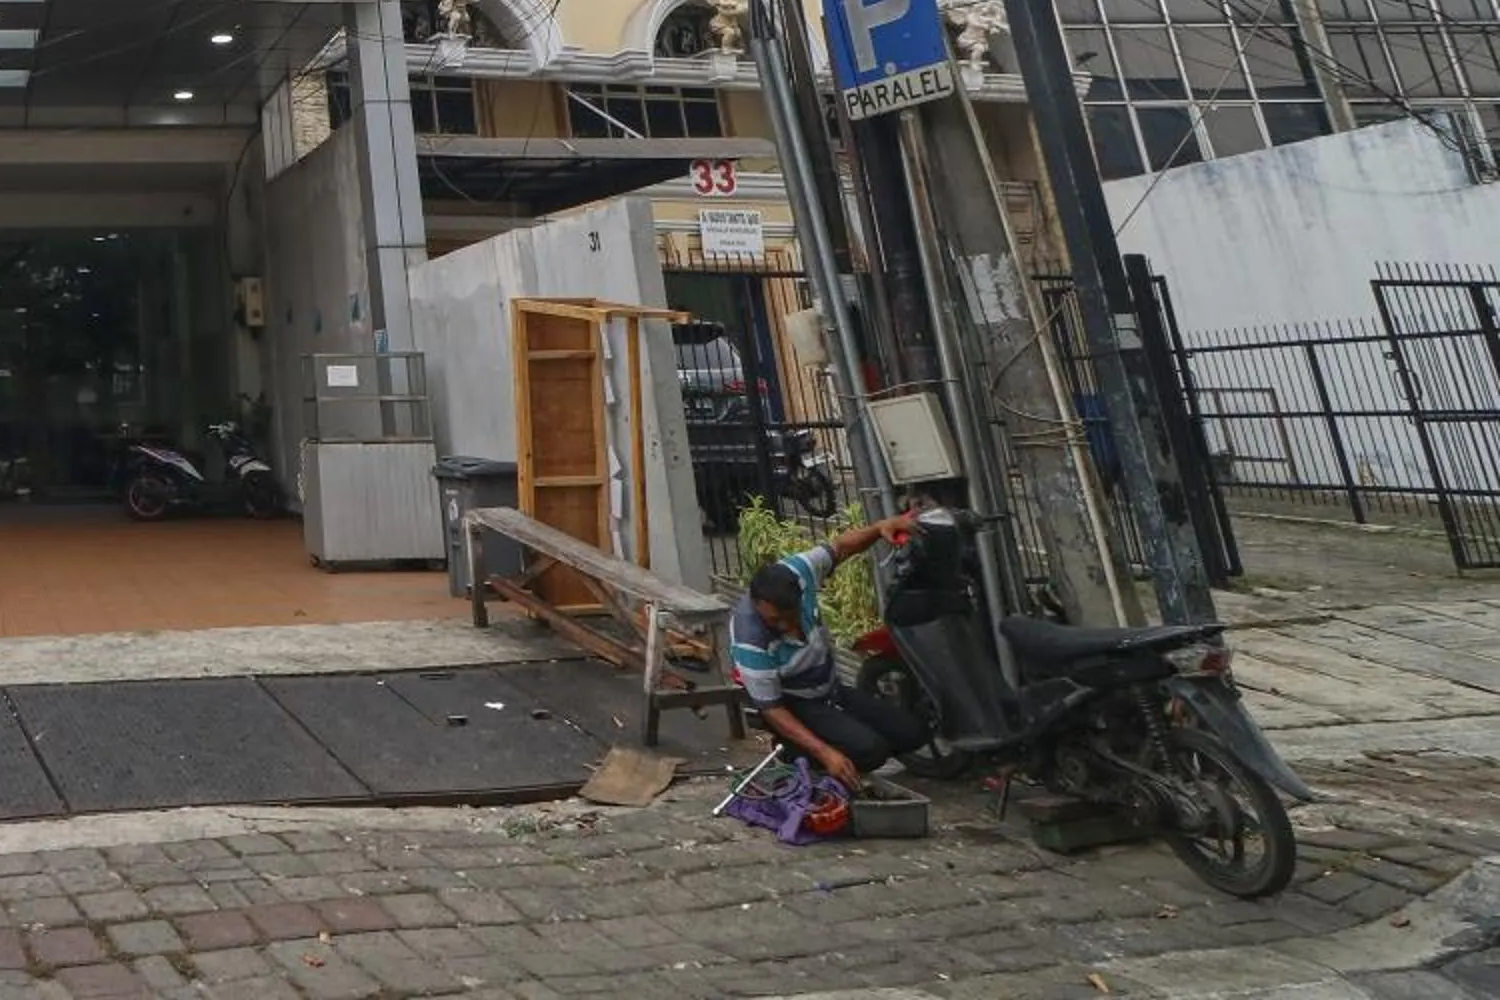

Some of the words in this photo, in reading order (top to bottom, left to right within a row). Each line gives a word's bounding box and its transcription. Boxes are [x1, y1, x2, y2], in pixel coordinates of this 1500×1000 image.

[847, 68, 950, 116] PARALEL
[691, 158, 736, 194] 33
[587, 231, 601, 252] 31
